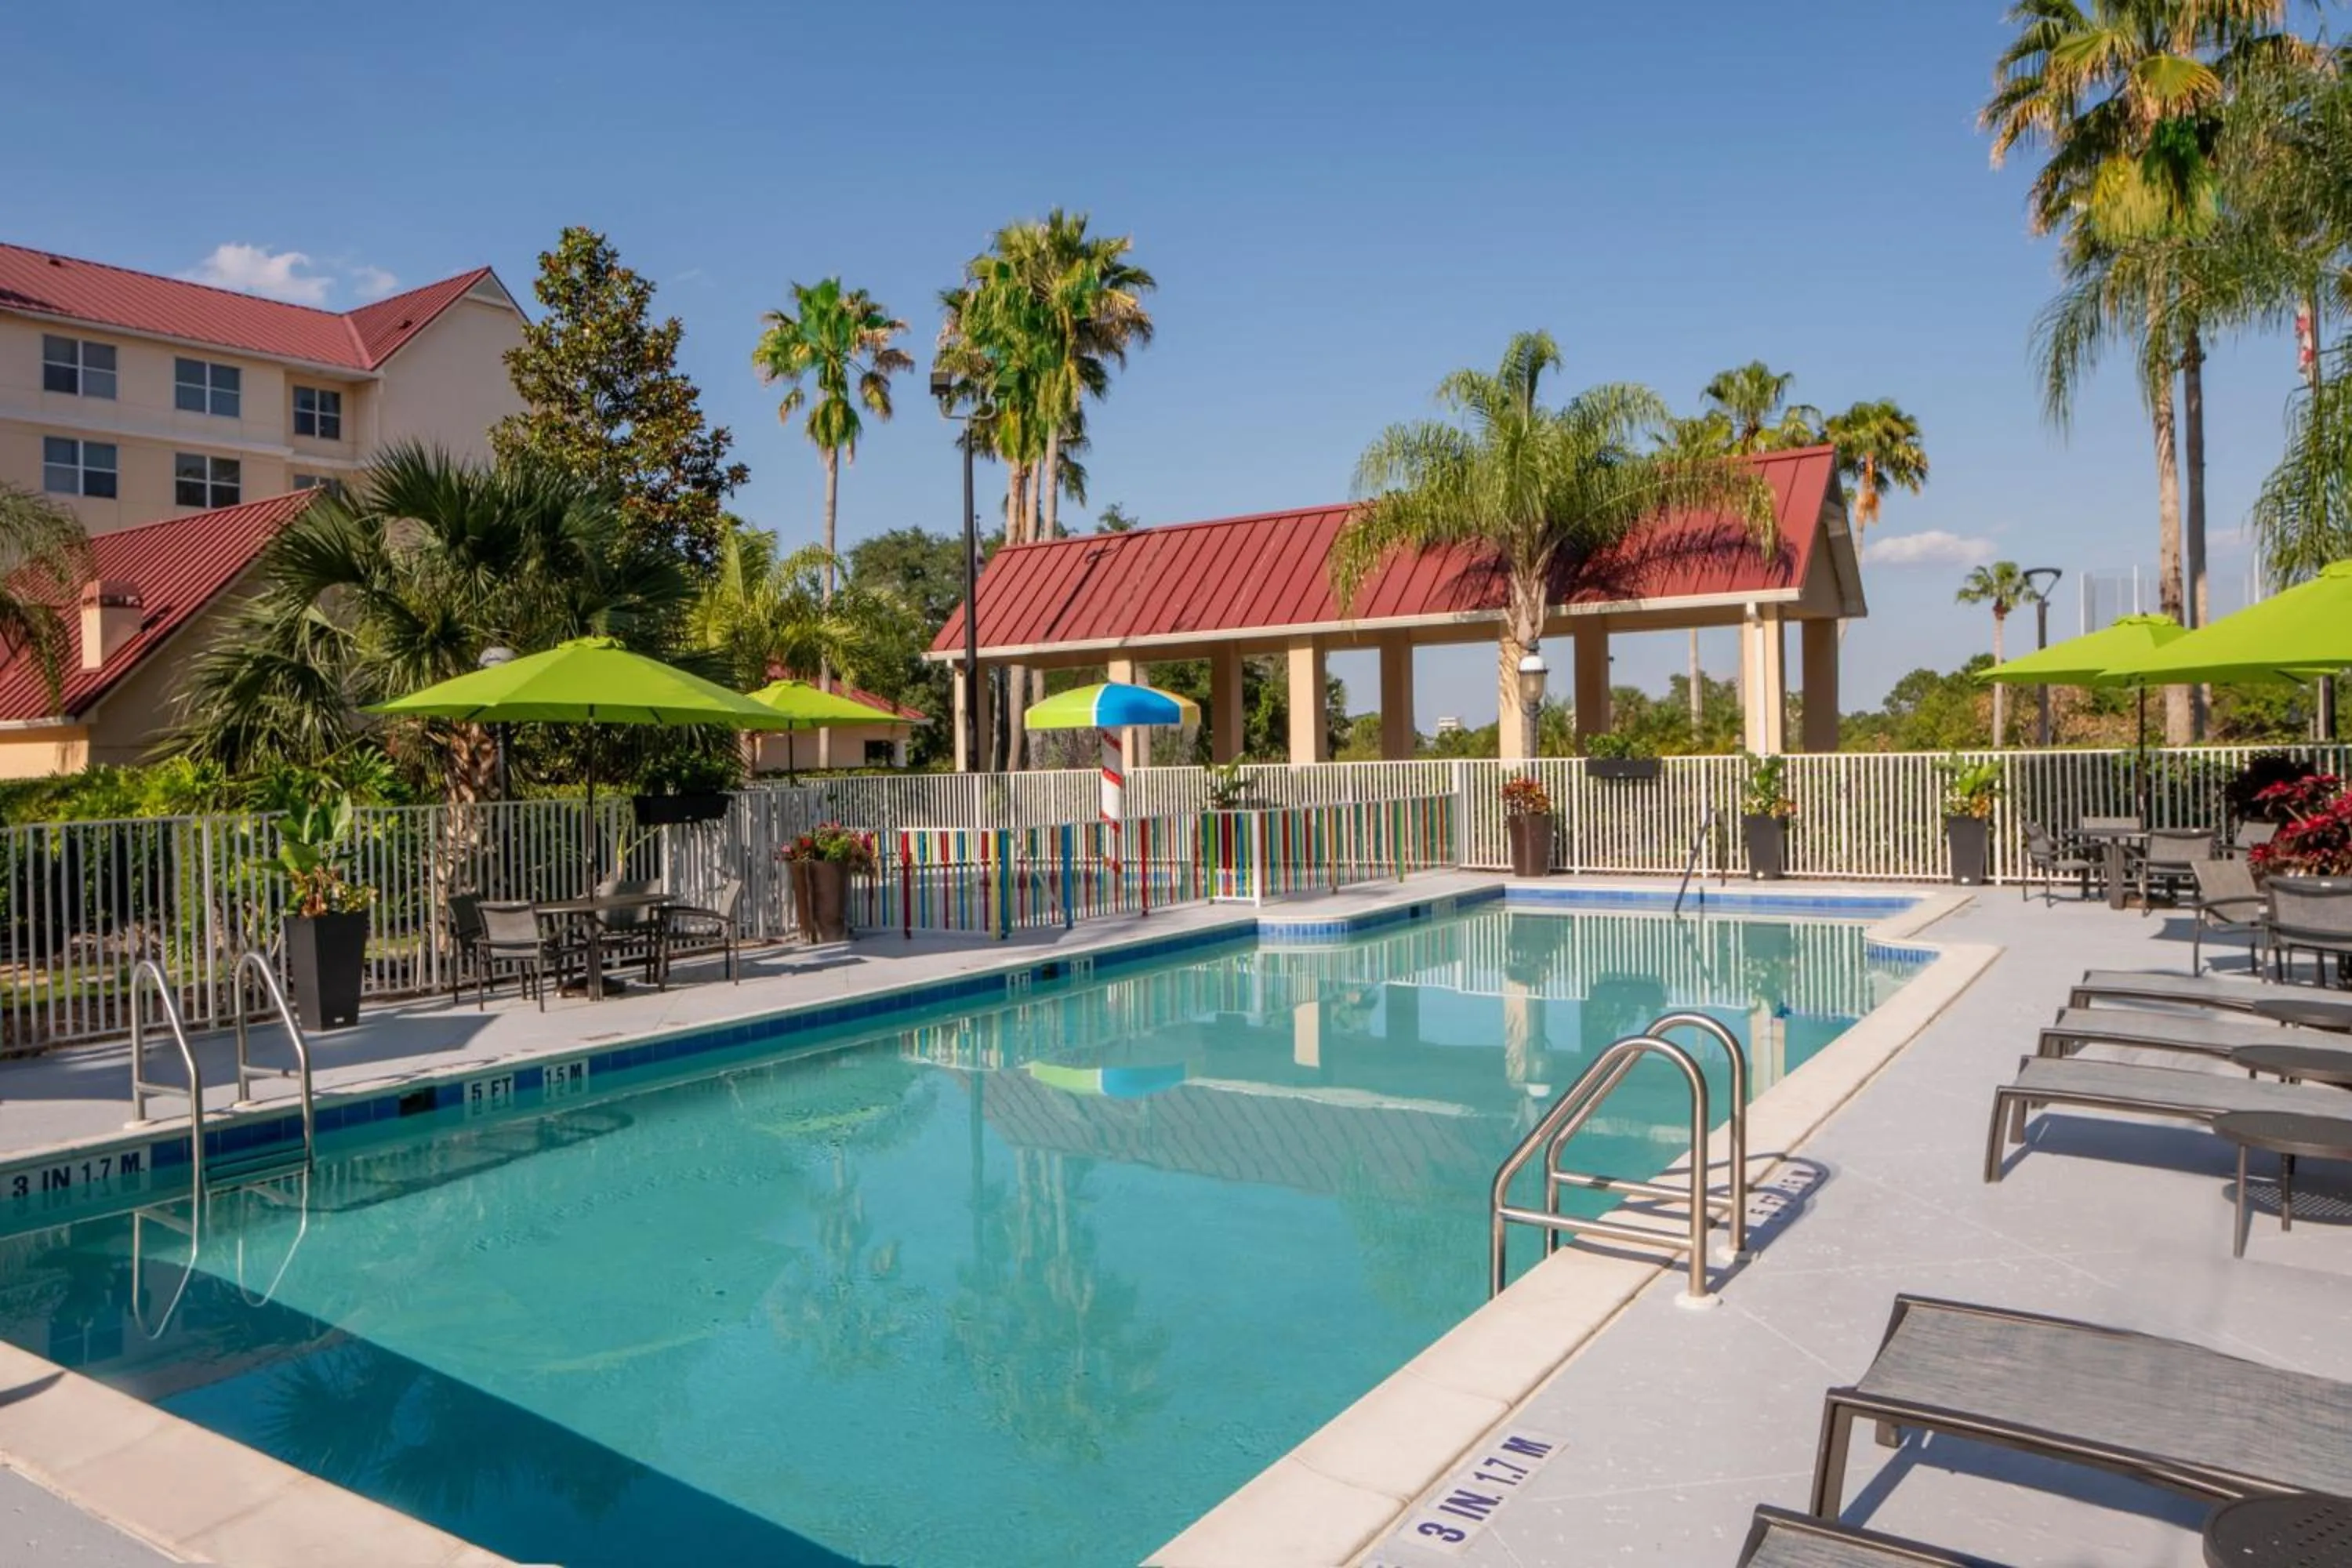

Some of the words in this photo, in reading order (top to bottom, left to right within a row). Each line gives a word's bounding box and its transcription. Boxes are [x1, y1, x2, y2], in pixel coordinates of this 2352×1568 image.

[570, 1062, 582, 1079] M
[472, 1083, 482, 1100] 5
[491, 1076, 512, 1096] FT
[13, 1175, 29, 1198] 3
[82, 1158, 112, 1182] 1.7
[1501, 1436, 1553, 1459] M
[1474, 1457, 1529, 1486] 1.7
[1438, 1489, 1504, 1522] IN.
[1417, 1522, 1465, 1543] 3
